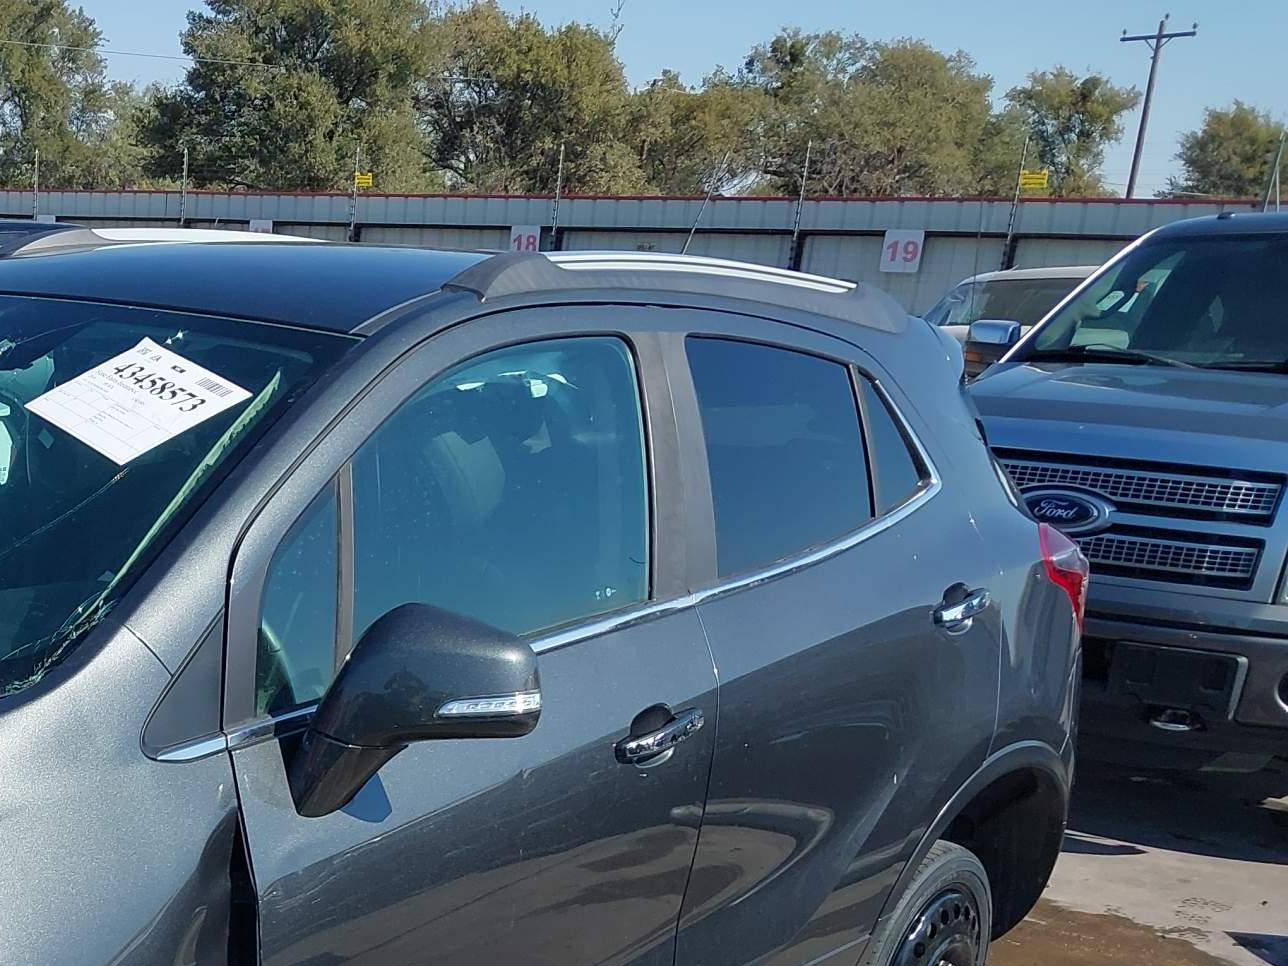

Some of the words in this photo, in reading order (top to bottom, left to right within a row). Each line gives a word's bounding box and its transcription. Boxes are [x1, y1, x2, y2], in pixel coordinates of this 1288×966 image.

[513, 234, 537, 251] 18
[886, 240, 919, 262] 19
[113, 362, 206, 412] 43458573
[1034, 499, 1079, 519] Ford
